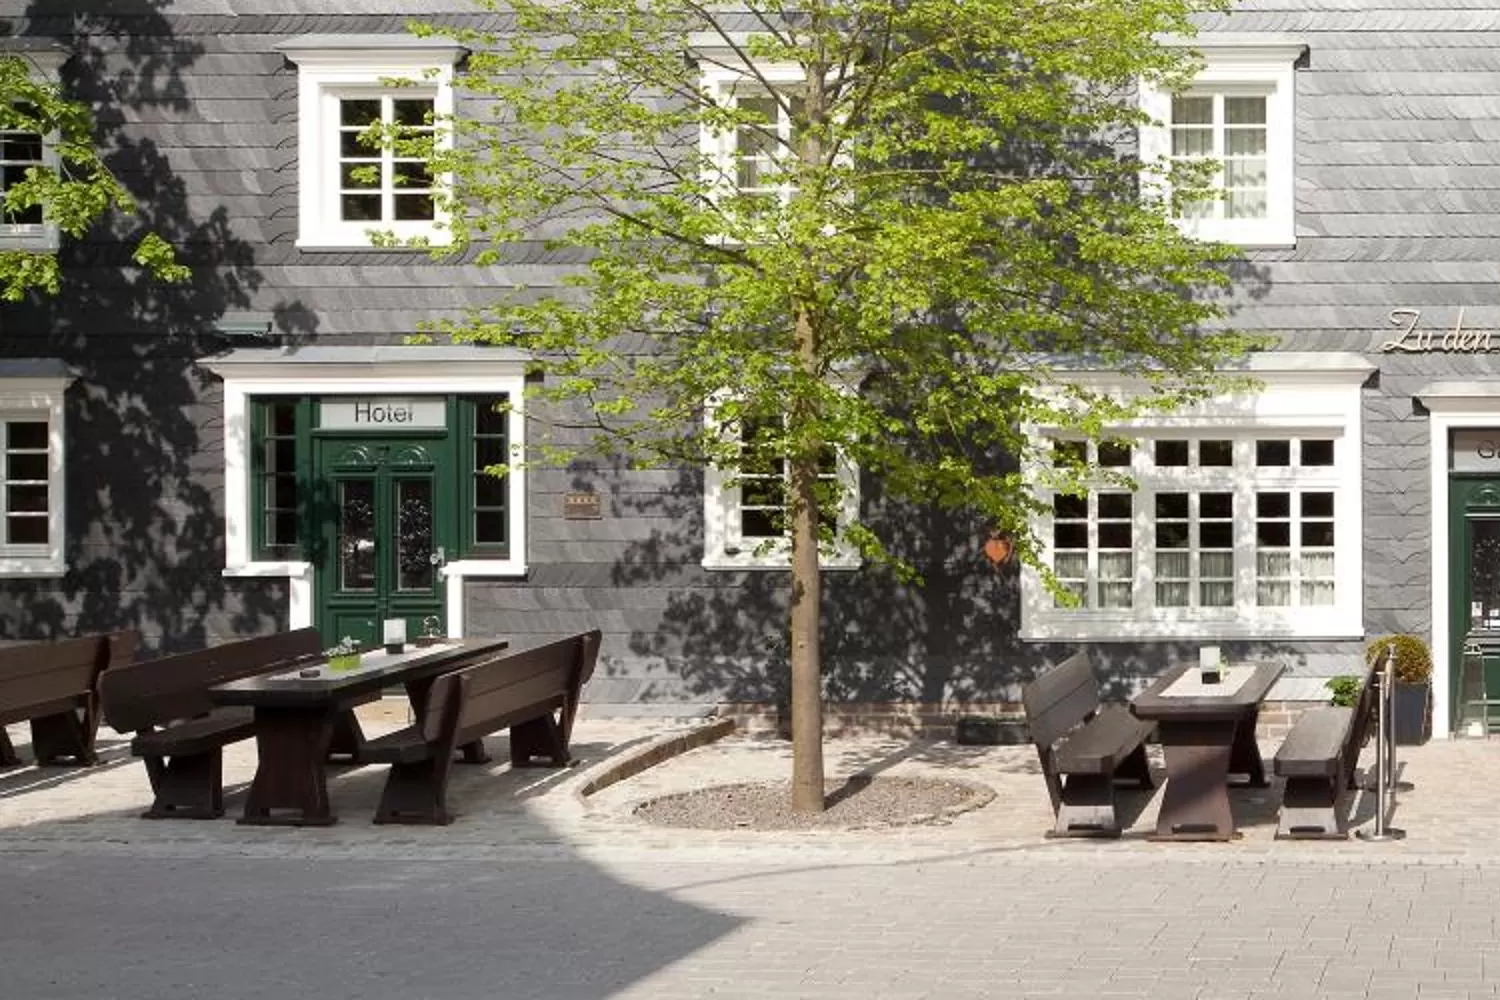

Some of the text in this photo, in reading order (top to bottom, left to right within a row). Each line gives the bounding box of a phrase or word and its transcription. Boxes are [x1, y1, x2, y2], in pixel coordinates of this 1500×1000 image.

[1384, 308, 1433, 352] Zu
[1442, 306, 1491, 352] den
[355, 400, 413, 423] Hotel
